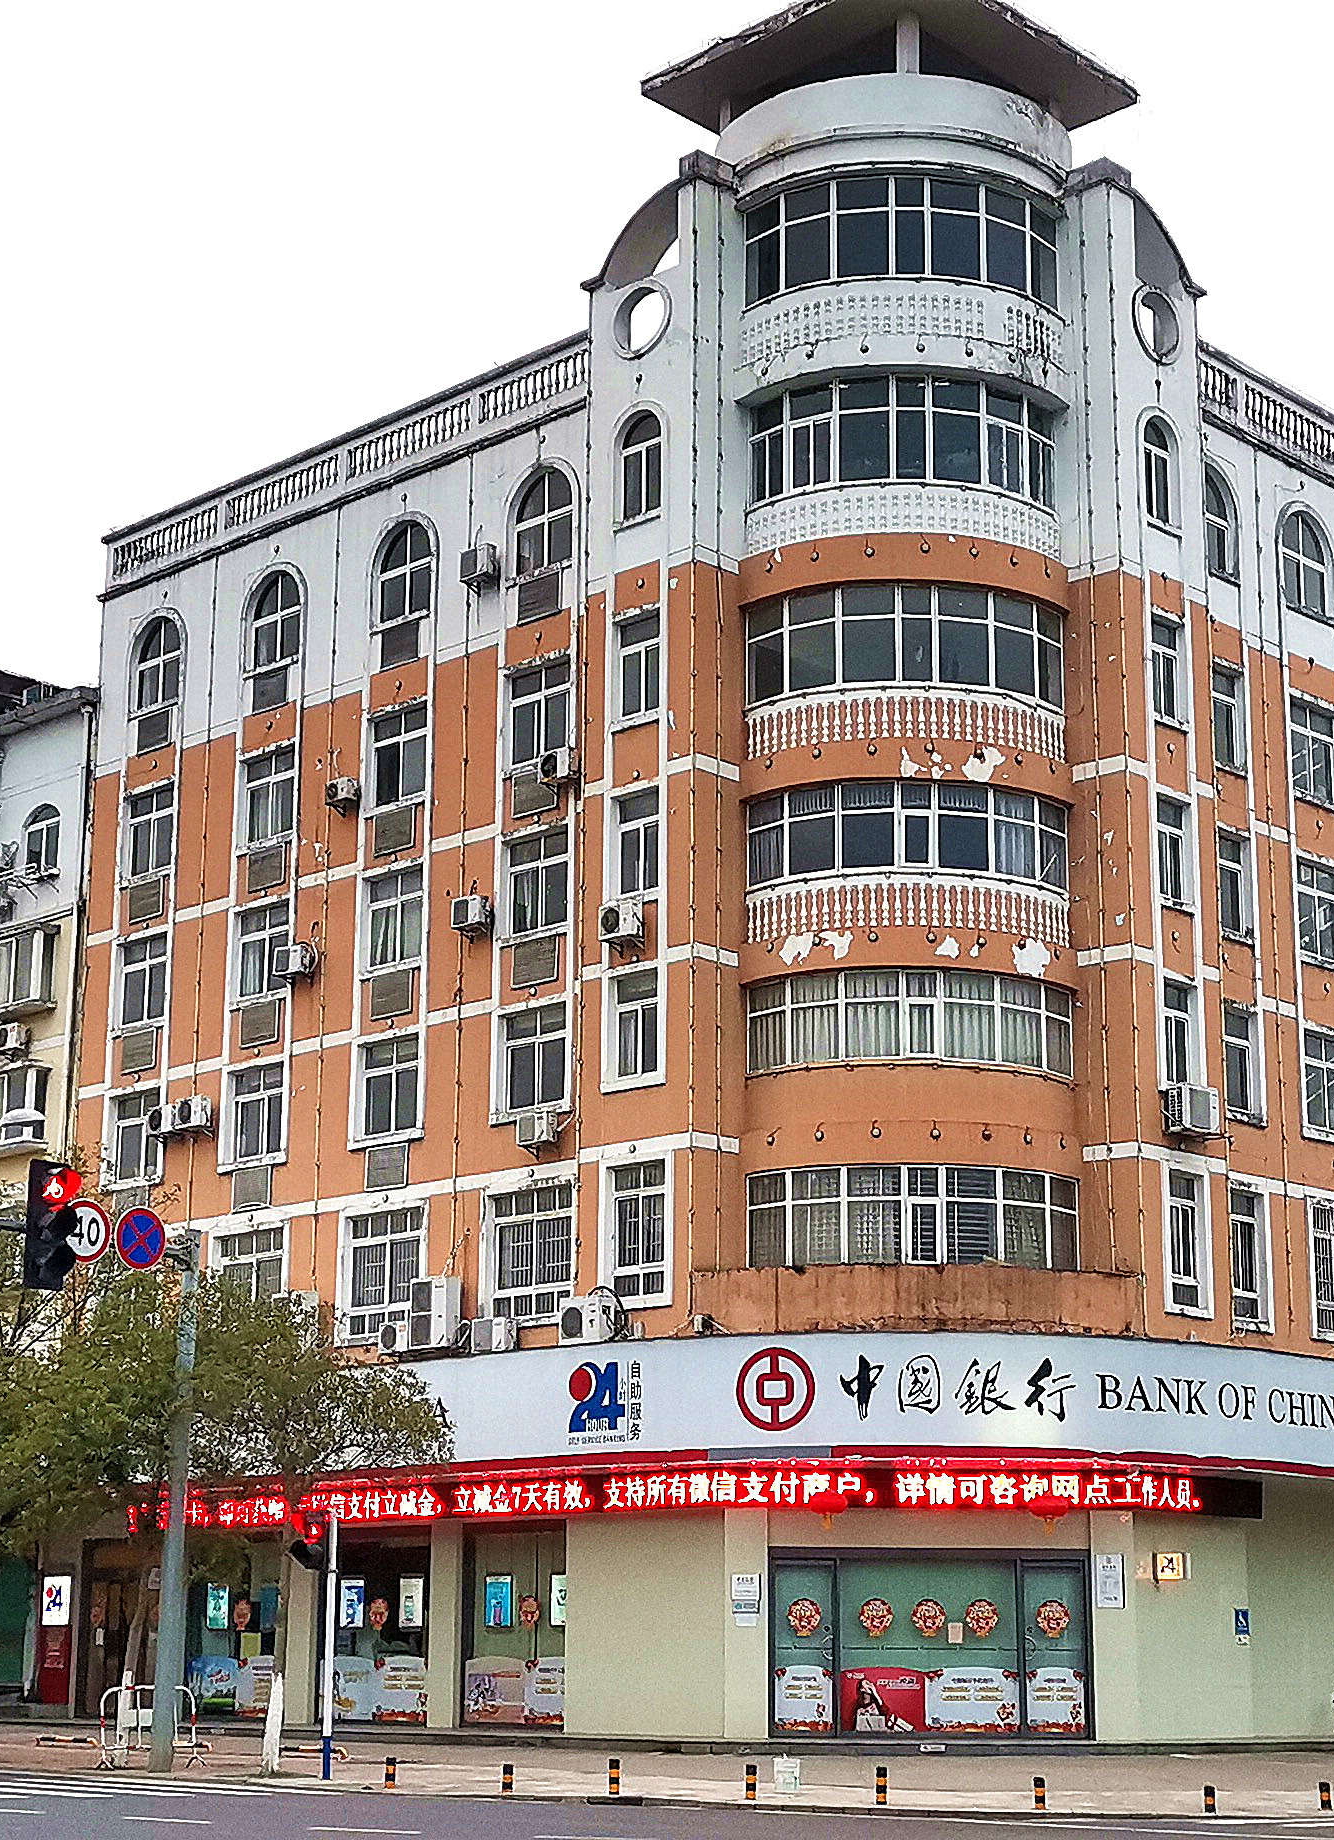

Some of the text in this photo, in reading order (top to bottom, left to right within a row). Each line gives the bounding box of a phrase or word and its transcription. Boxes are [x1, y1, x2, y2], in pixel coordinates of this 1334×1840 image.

[71, 1216, 100, 1247] 40
[569, 1362, 625, 1433] 24
[630, 1361, 642, 1441] 自助服务
[1095, 1374, 1208, 1415] BANK
[1218, 1383, 1257, 1420] OF
